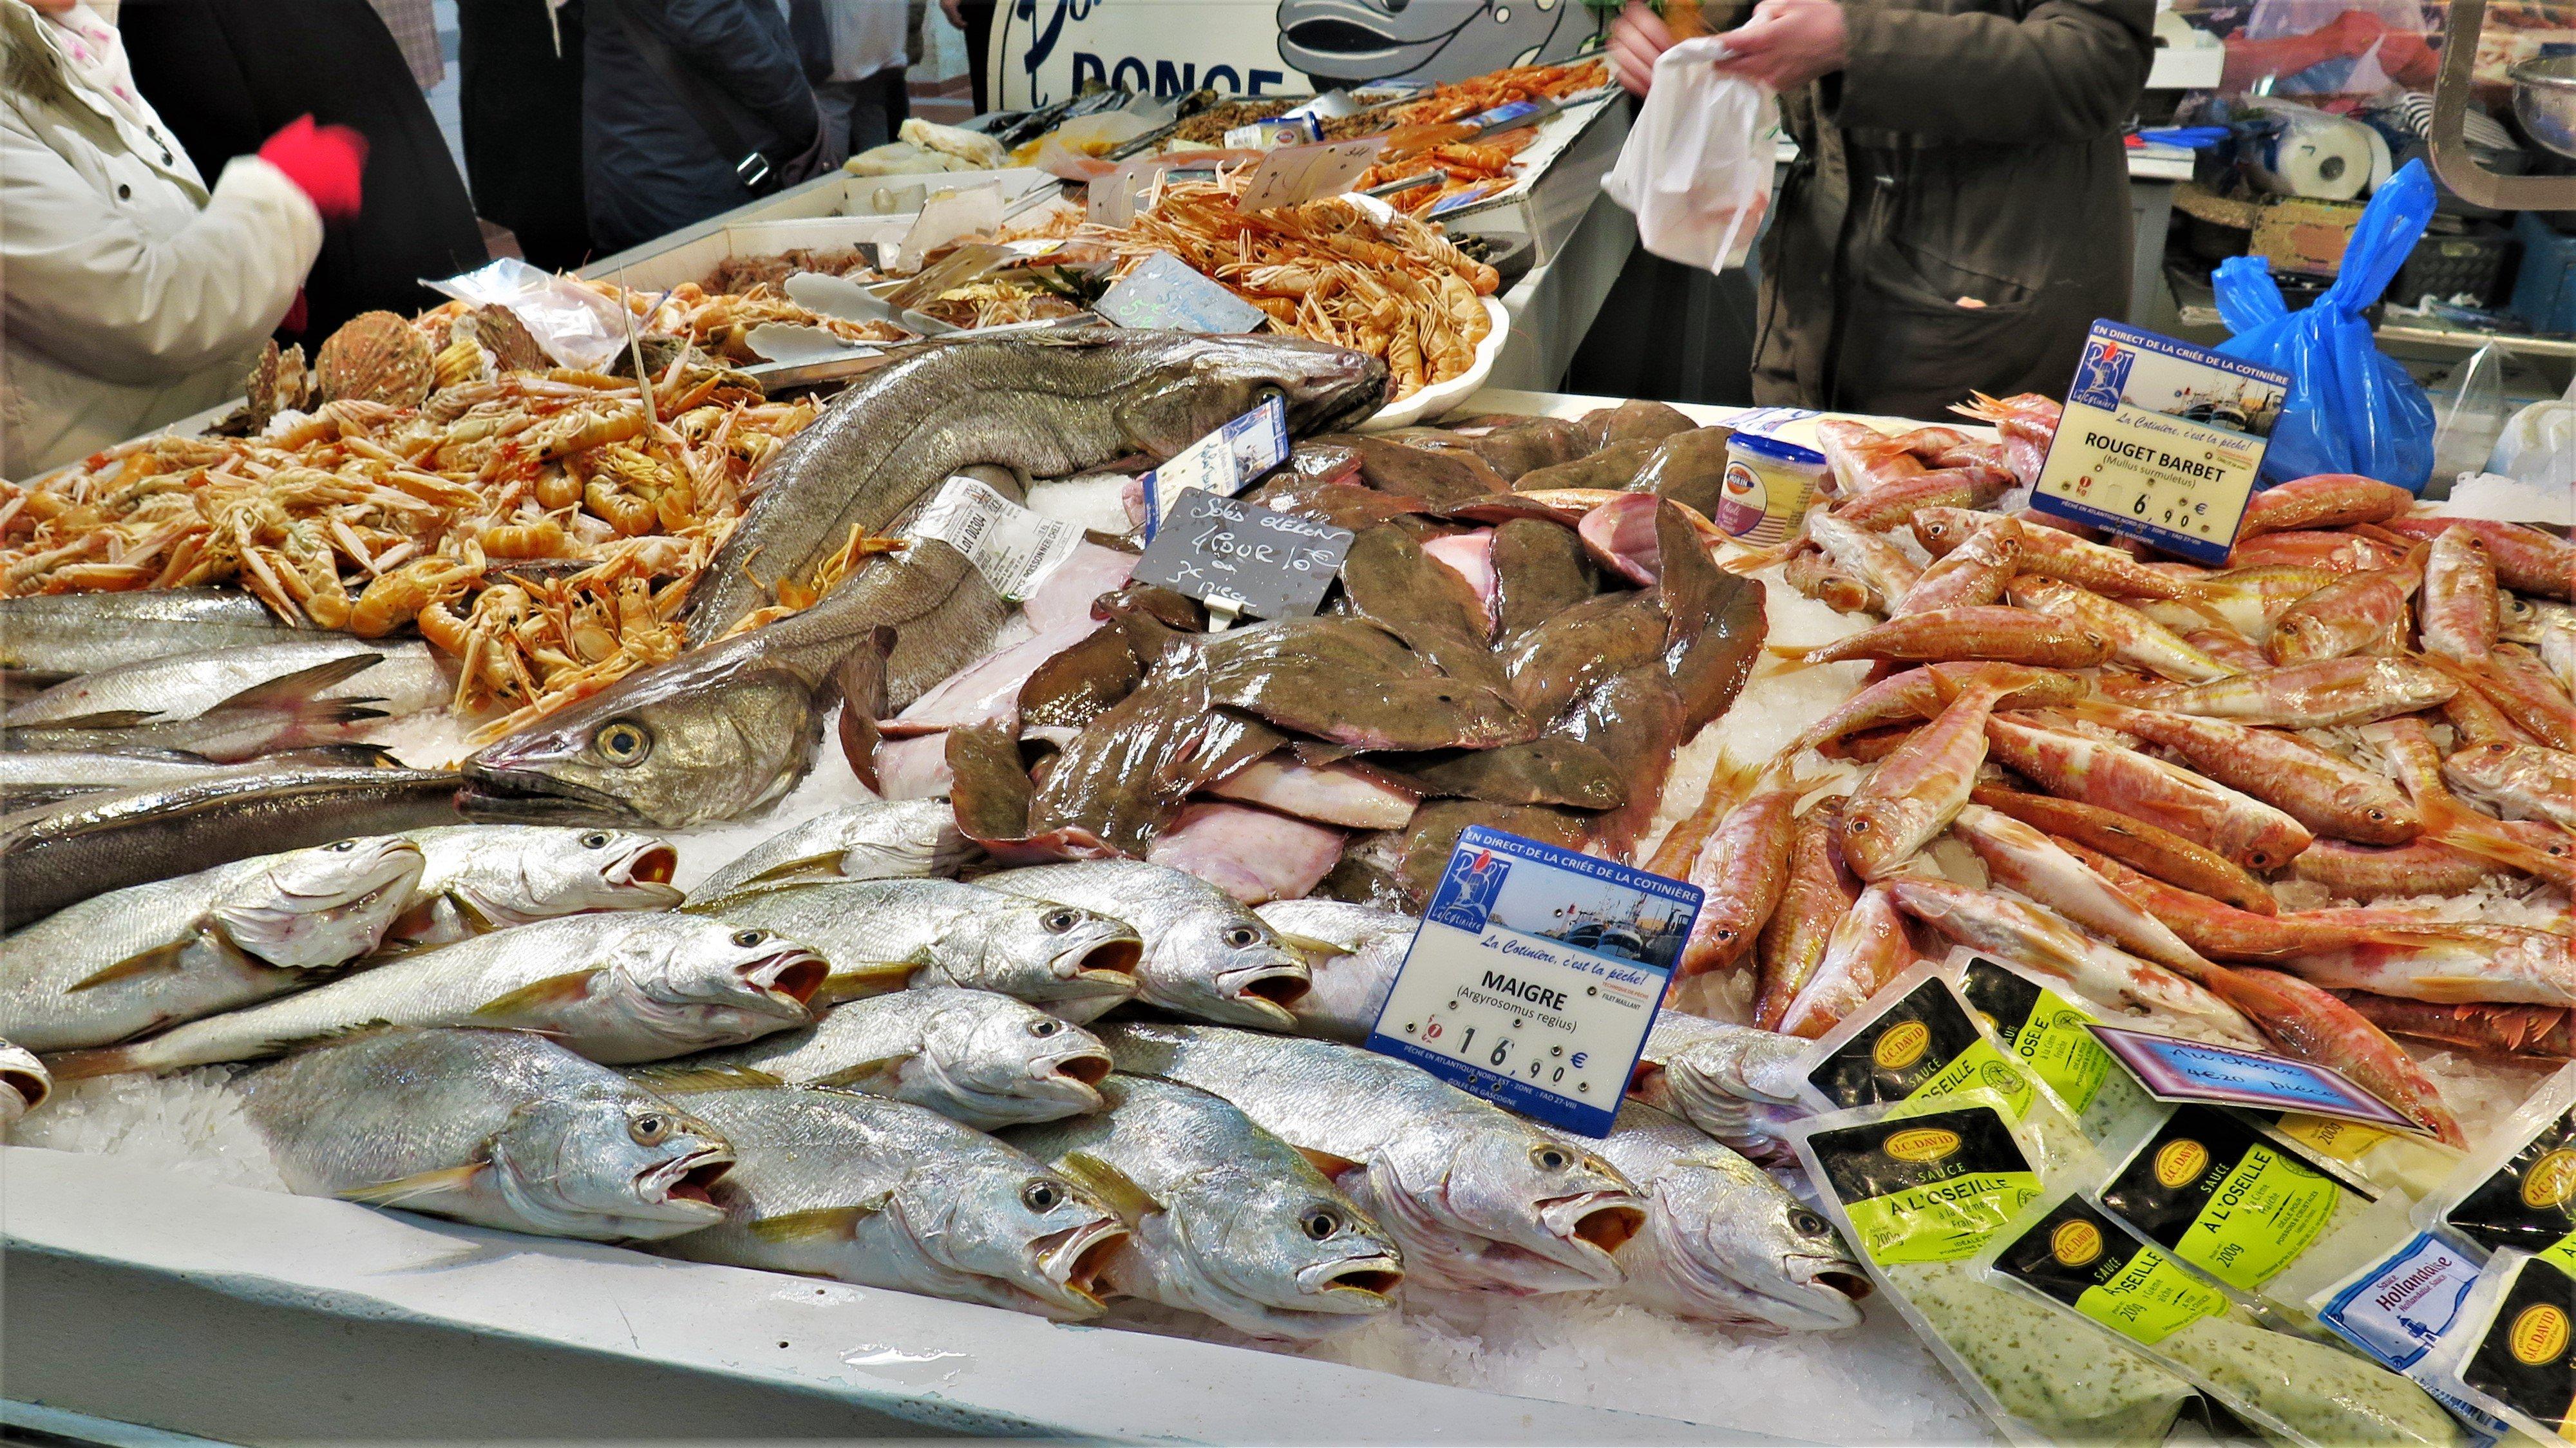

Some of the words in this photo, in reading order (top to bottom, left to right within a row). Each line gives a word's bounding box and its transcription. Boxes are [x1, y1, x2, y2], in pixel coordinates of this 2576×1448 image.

[2094, 325, 2108, 335] EN
[2109, 330, 2145, 346] DIRECT
[2146, 339, 2161, 349] DE
[2161, 343, 2174, 354] LA
[2175, 347, 2204, 362] CRIÉE
[2206, 356, 2221, 366] DE
[2222, 359, 2234, 370] LA
[2236, 365, 2289, 385] COTINIÈRE
[2208, 434, 2218, 443] la
[2085, 432, 2157, 462] ROUGET
[2159, 453, 2226, 482] BARBET
[2103, 454, 2138, 472] (Mullus
[2141, 466, 2197, 490] surmuletus)
[956, 535, 974, 555] Lot
[1211, 532, 1274, 564] POUR
[1466, 832, 1481, 841] EN
[1483, 835, 1524, 852] DIRECT
[1525, 847, 1542, 859] DE
[1544, 852, 1558, 863] LA
[1561, 857, 1595, 873] CRIÉE
[1596, 866, 1613, 878] DE
[1615, 872, 1630, 883] LA
[1633, 877, 1699, 903] COTINIÈRE
[1481, 935, 1499, 949] La
[1502, 940, 1557, 964] Cotinière,
[1563, 954, 1587, 971] c'est
[1591, 962, 1605, 975] la
[1605, 968, 1650, 986] pêche!
[1481, 971, 1567, 1011] MAIGRE
[1602, 993, 1616, 1002] FILET
[1457, 985, 1535, 1018] (Argyrosomus
[1537, 1012, 1578, 1034] regius)
[1895, 1027, 1925, 1052] DAVID
[1425, 1051, 1435, 1060] EN
[1435, 1054, 1476, 1075] ATLANTIQUE
[1514, 1083, 1533, 1094] ZONE
[1908, 1057, 1942, 1087] SAUCE
[1470, 1085, 1481, 1094] DE
[1893, 1141, 1915, 1154] J.C.
[1915, 1134, 1954, 1148] DAVID
[2318, 1122, 2344, 1145] 200g
[2174, 1143, 2198, 1167] DAVID
[1917, 1162, 1966, 1183] SAUCE
[2200, 1163, 2230, 1194] SAUCE
[1907, 1178, 2013, 1211] L'OSEILLE
[2199, 1221, 2221, 1234] À
[2211, 1151, 2273, 1221] L'OSEILLE
[2530, 1181, 2553, 1202] J.C.
[2071, 1226, 2095, 1248] DAVID
[2094, 1257, 2122, 1282] SAUCE
[2215, 1243, 2245, 1268] 200g
[2375, 1257, 2452, 1311] Hollandaise
[2531, 1311, 2557, 1345] DAVID
[2523, 1344, 2540, 1360] J.C.
